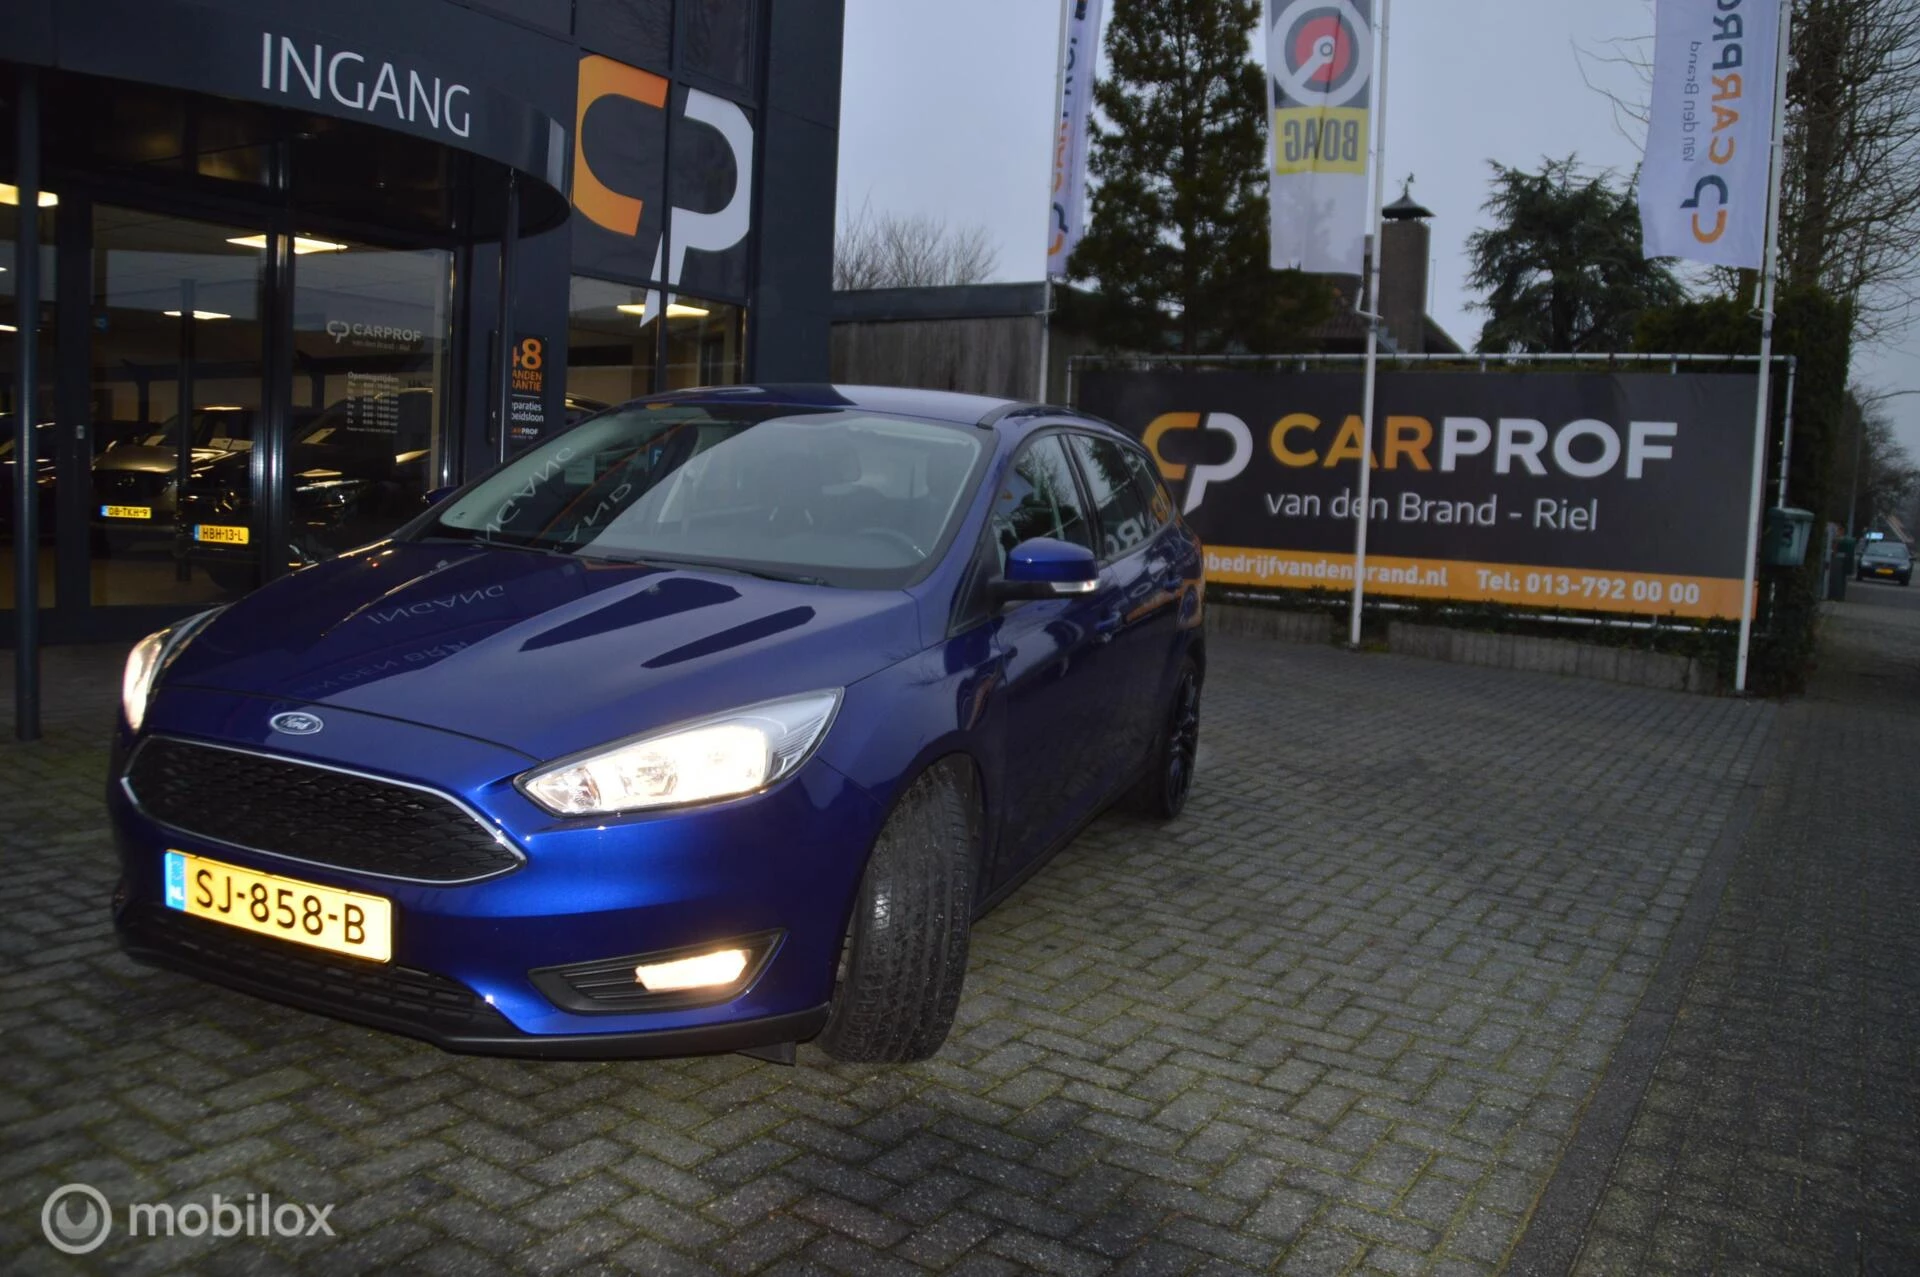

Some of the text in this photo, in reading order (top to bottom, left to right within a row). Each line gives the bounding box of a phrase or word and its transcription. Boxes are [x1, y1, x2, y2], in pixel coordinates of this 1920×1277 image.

[261, 32, 471, 137] INGANG
[352, 323, 423, 342] CARPROF
[511, 370, 543, 382] ANDEN
[511, 401, 542, 412] paraties
[1270, 413, 1678, 479] CARPROF
[1267, 493, 1320, 517] van
[1331, 488, 1389, 519] den
[1401, 492, 1498, 526] Brand
[1534, 498, 1598, 531] Riel
[202, 527, 243, 542] HBH-13-L
[1203, 552, 1700, 604] bedrijfvandenrand.nl Tel: 013-792 00 00
[280, 716, 312, 730] Ford
[196, 869, 365, 945] SJ-858-B
